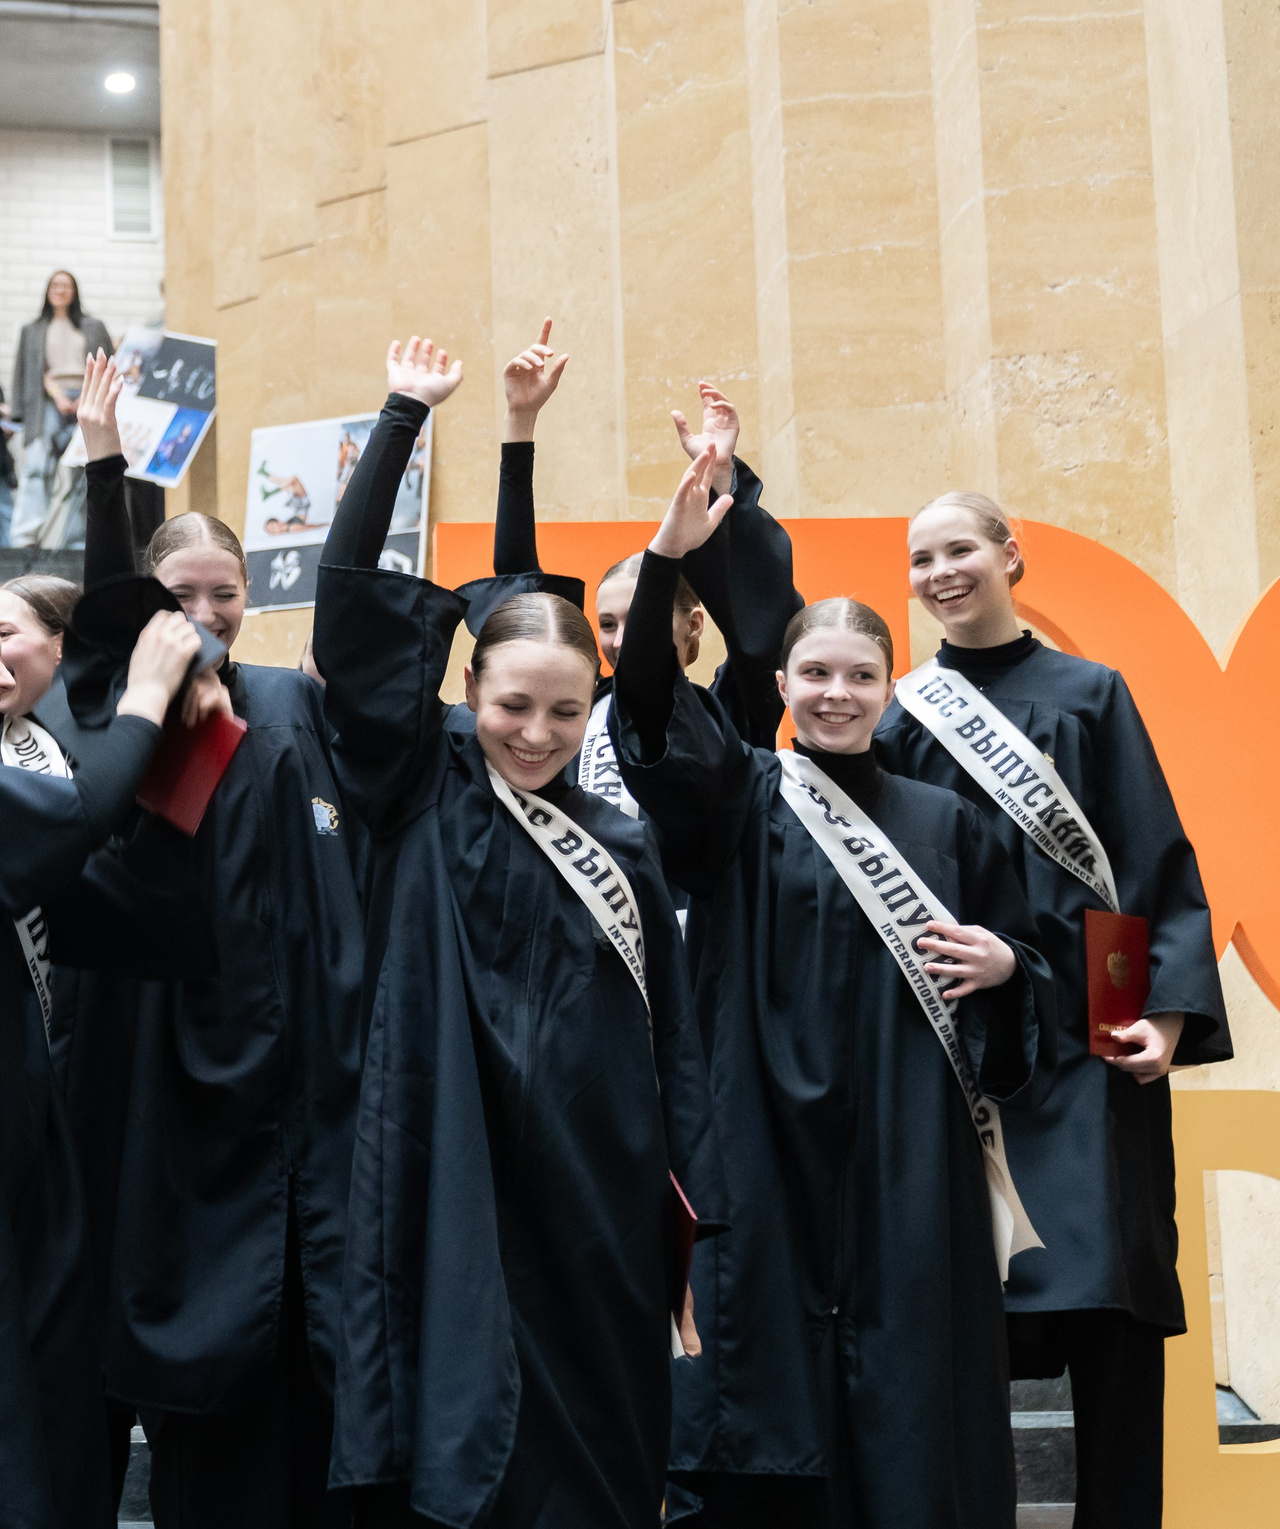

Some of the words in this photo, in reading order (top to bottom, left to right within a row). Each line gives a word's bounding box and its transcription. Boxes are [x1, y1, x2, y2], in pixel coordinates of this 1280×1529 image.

[916, 676, 969, 719] IDC
[581, 735, 597, 791] INTERNATIO
[995, 788, 1058, 859] INTERNATIONAL
[1060, 856, 1092, 883] DANCE
[881, 923, 943, 1023] INTERNATIONAL
